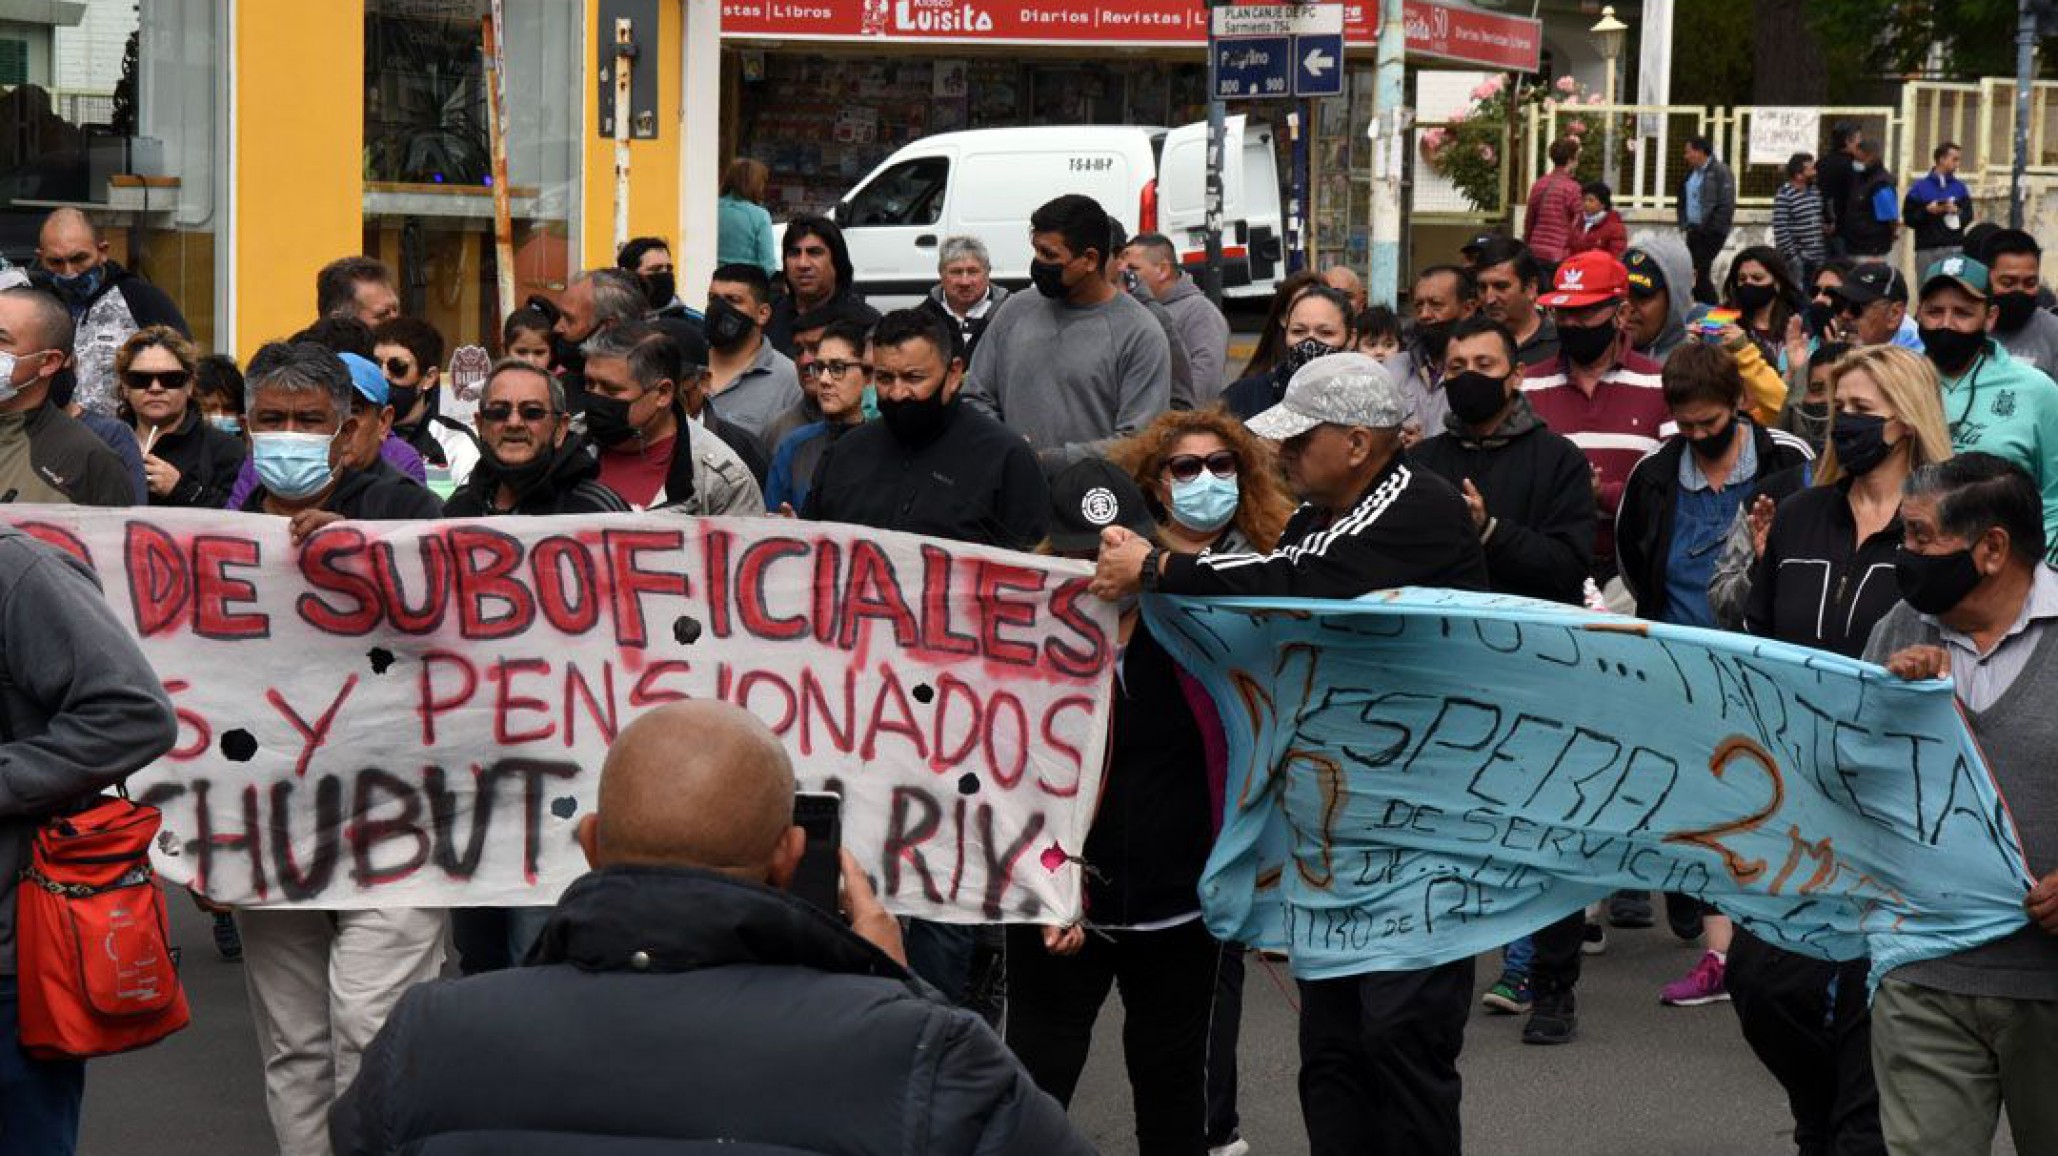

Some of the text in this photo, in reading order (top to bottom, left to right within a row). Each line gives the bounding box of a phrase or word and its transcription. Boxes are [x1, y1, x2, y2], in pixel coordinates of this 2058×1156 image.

[774, 5, 832, 18] Libros
[1020, 9, 1089, 24] Diarios
[1103, 11, 1181, 24] Revistas
[124, 520, 271, 639] DE
[297, 525, 1112, 679] SUBOFICIALES
[266, 674, 359, 775] Y
[1296, 687, 1679, 838] ESPERA
[1369, 799, 1444, 833] DE
[1660, 733, 1784, 892] 2
